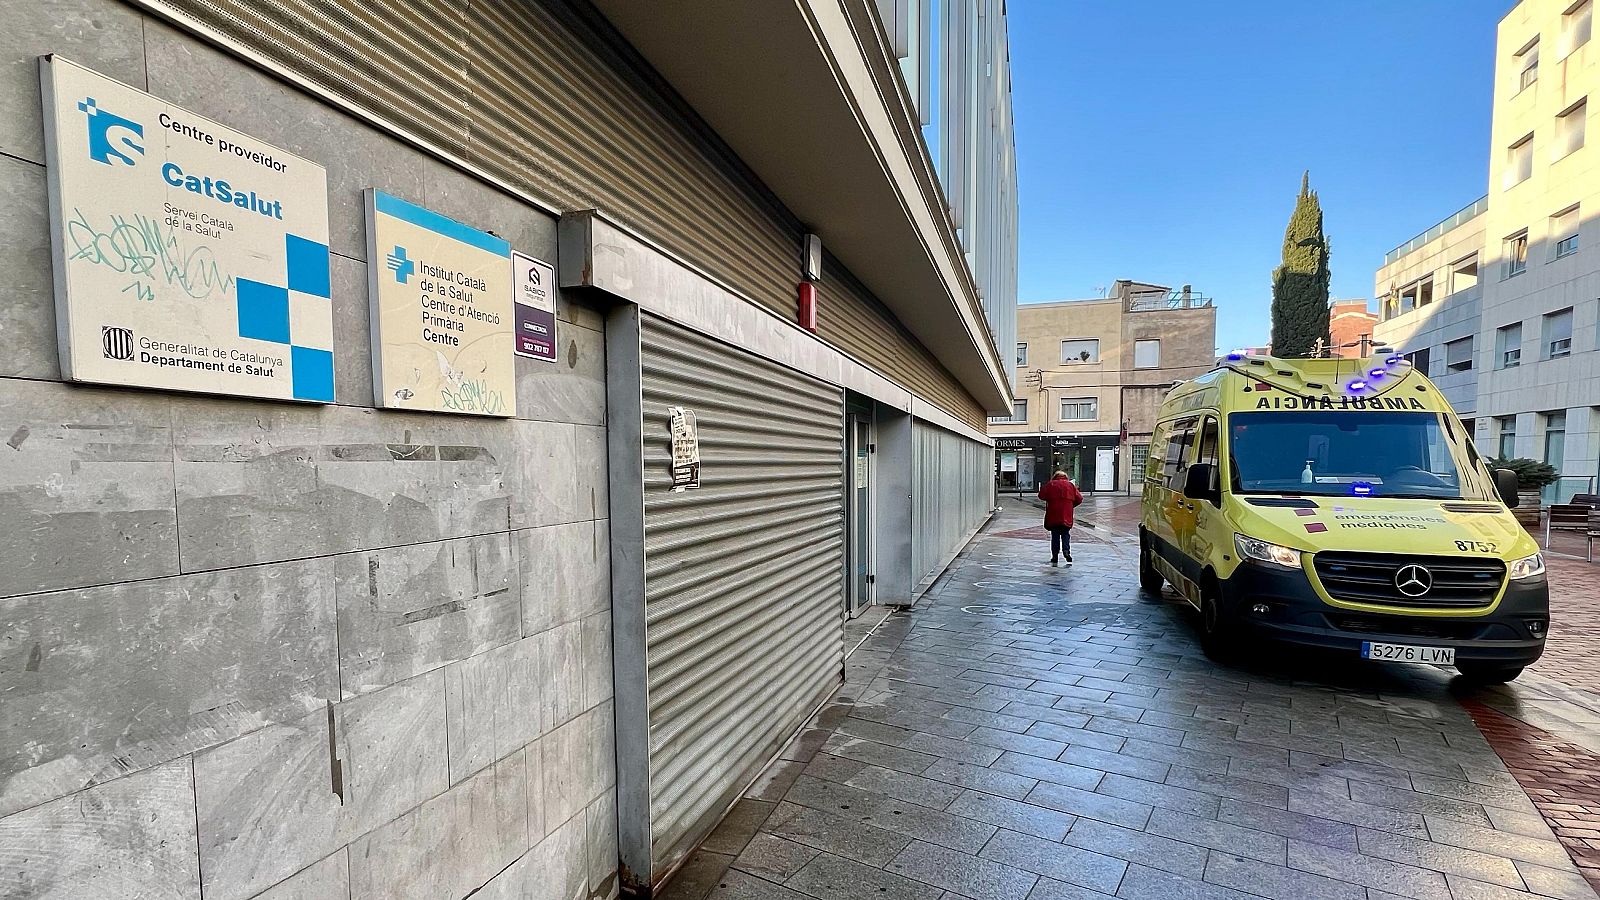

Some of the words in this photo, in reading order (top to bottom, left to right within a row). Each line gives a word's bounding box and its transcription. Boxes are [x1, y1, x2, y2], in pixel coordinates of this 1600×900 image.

[159, 113, 214, 145] Centre
[218, 138, 287, 173] proveïdor
[161, 162, 283, 220] CatSalut
[163, 202, 198, 220] Servei
[201, 213, 234, 231] Català
[164, 215, 179, 228] de
[182, 219, 192, 231] la
[195, 223, 222, 239] Salut
[420, 260, 454, 282] Institut
[456, 272, 486, 292] Català
[420, 278, 434, 292] de
[436, 281, 447, 296] la
[448, 285, 474, 303] Salut
[421, 294, 456, 315] Centre
[458, 304, 500, 325] d'Atenció
[422, 311, 465, 332] Primària
[423, 328, 459, 346] Centre
[139, 336, 209, 357] Generalitat
[212, 347, 227, 359] de
[230, 349, 284, 367] Catalunya
[140, 351, 225, 372] Departament
[228, 362, 242, 374] de
[245, 364, 274, 378] Salut
[1454, 540, 1500, 554] 8752
[1373, 644, 1415, 660] 5276
[1420, 648, 1451, 663] LVN
